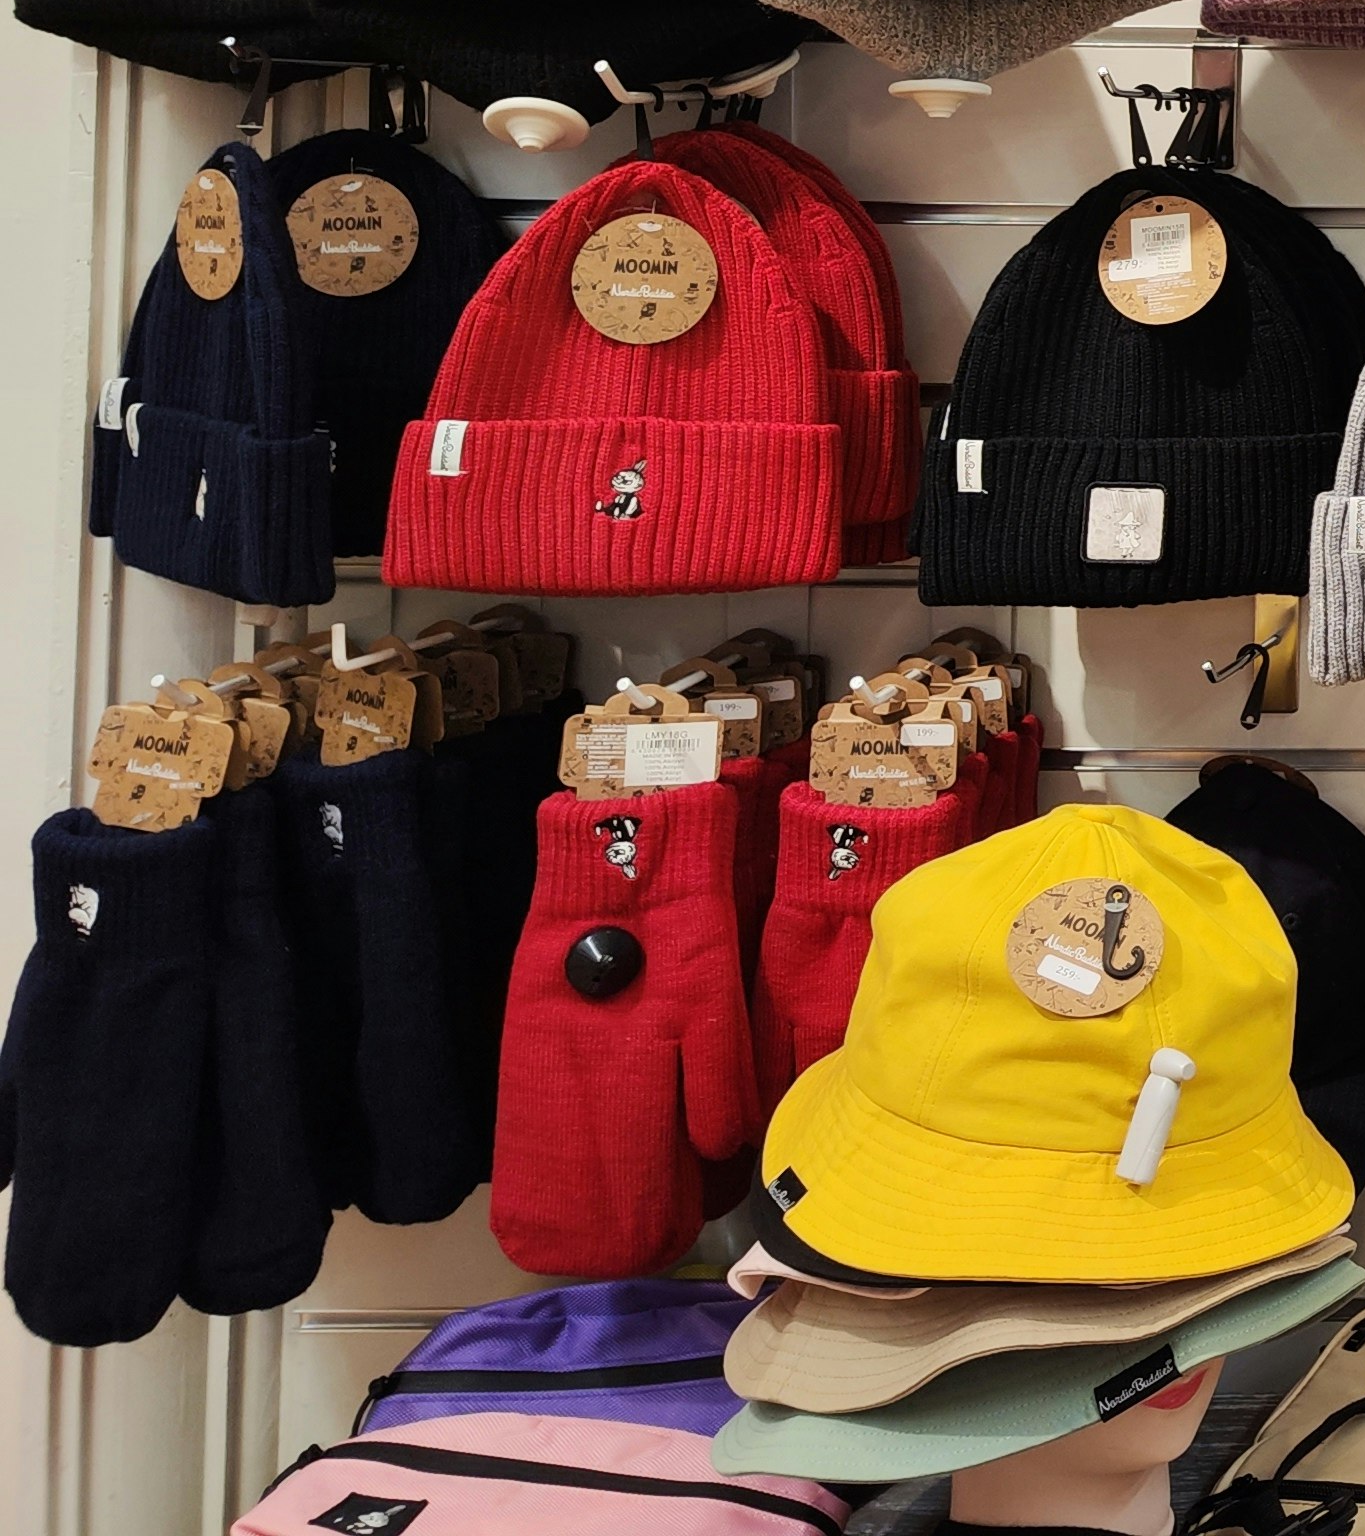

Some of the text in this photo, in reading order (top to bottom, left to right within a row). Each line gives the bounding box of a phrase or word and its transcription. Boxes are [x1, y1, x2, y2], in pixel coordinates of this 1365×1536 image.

[321, 216, 382, 232] MOOMIN
[614, 257, 678, 275] MOOMIN
[132, 734, 190, 756] MOOMIN
